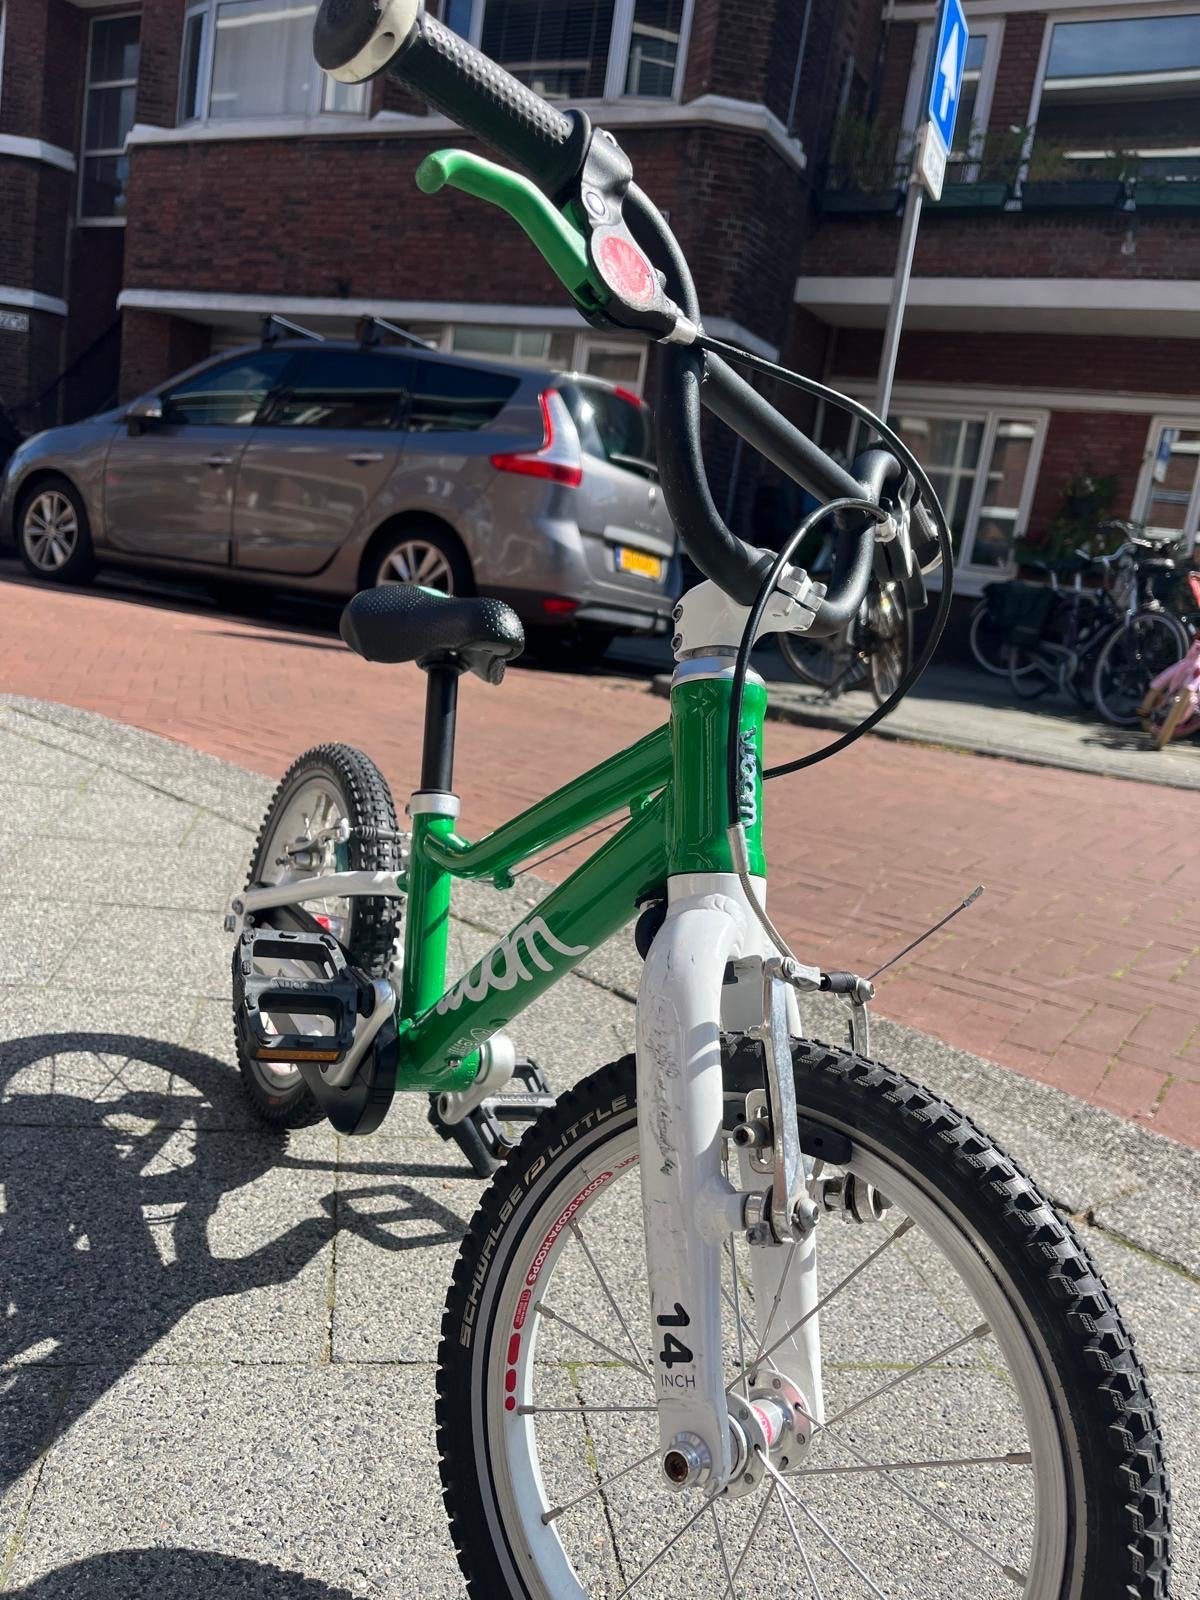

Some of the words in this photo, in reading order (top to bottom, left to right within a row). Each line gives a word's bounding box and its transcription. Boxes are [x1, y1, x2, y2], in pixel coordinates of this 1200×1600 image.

[437, 916, 590, 1015] woom
[459, 1184, 523, 1347] SCHWALBE
[548, 1094, 628, 1158] LITTLE
[657, 1302, 693, 1369] 14
[660, 1374, 696, 1388] INCH
